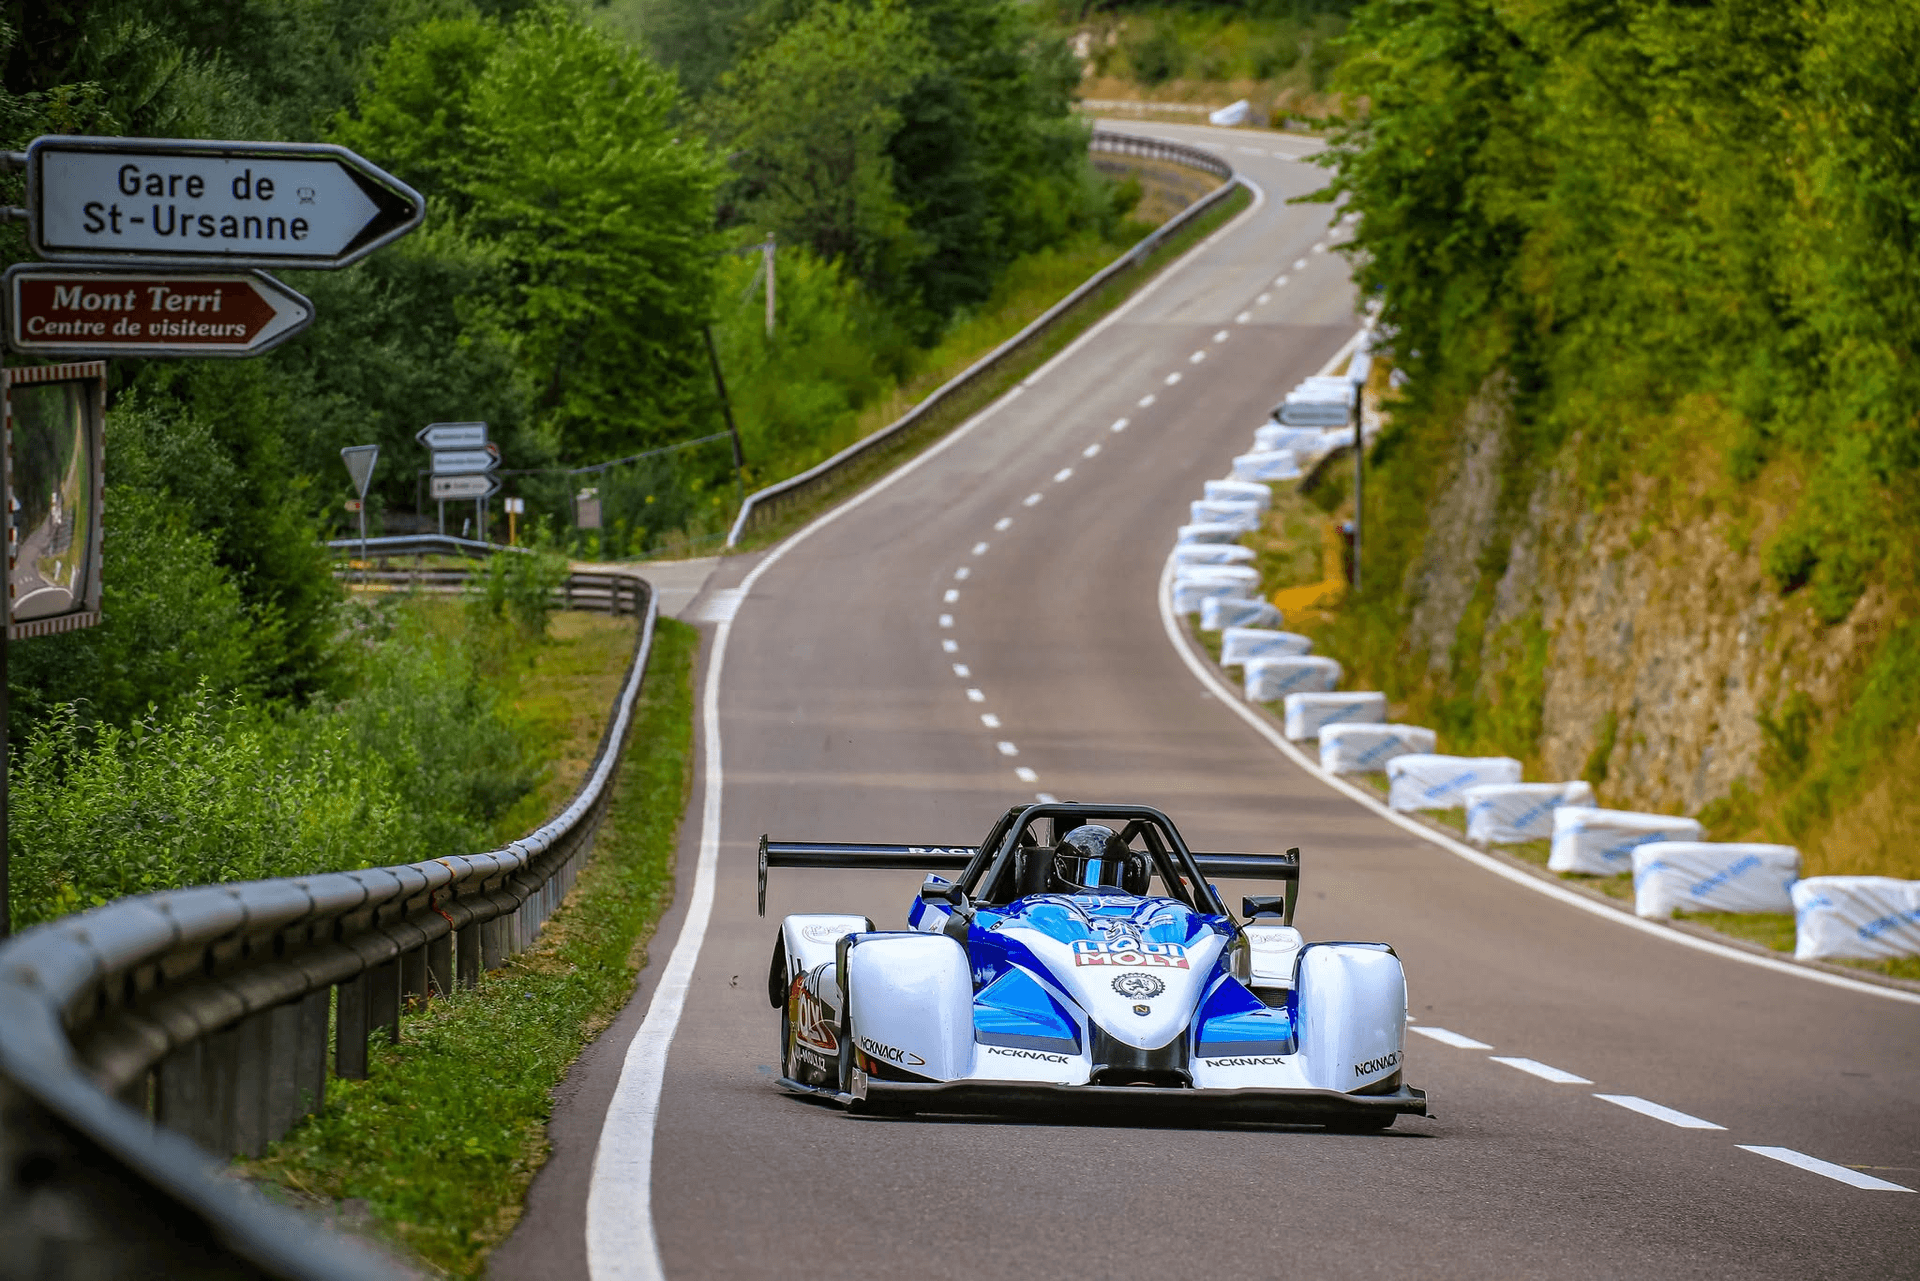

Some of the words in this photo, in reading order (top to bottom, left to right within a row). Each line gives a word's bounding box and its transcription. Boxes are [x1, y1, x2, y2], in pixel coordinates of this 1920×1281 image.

[118, 164, 205, 198] Gare
[231, 168, 275, 200] de
[82, 201, 310, 241] St-Ursanne
[51, 285, 136, 312] Mont
[147, 286, 222, 313] Terri
[26, 316, 106, 336] Centre
[112, 317, 141, 336] de
[148, 318, 247, 337] visiteurs
[908, 847, 979, 855] RACI
[1077, 937, 1184, 957] LIQUI
[1080, 951, 1187, 968] MOLY
